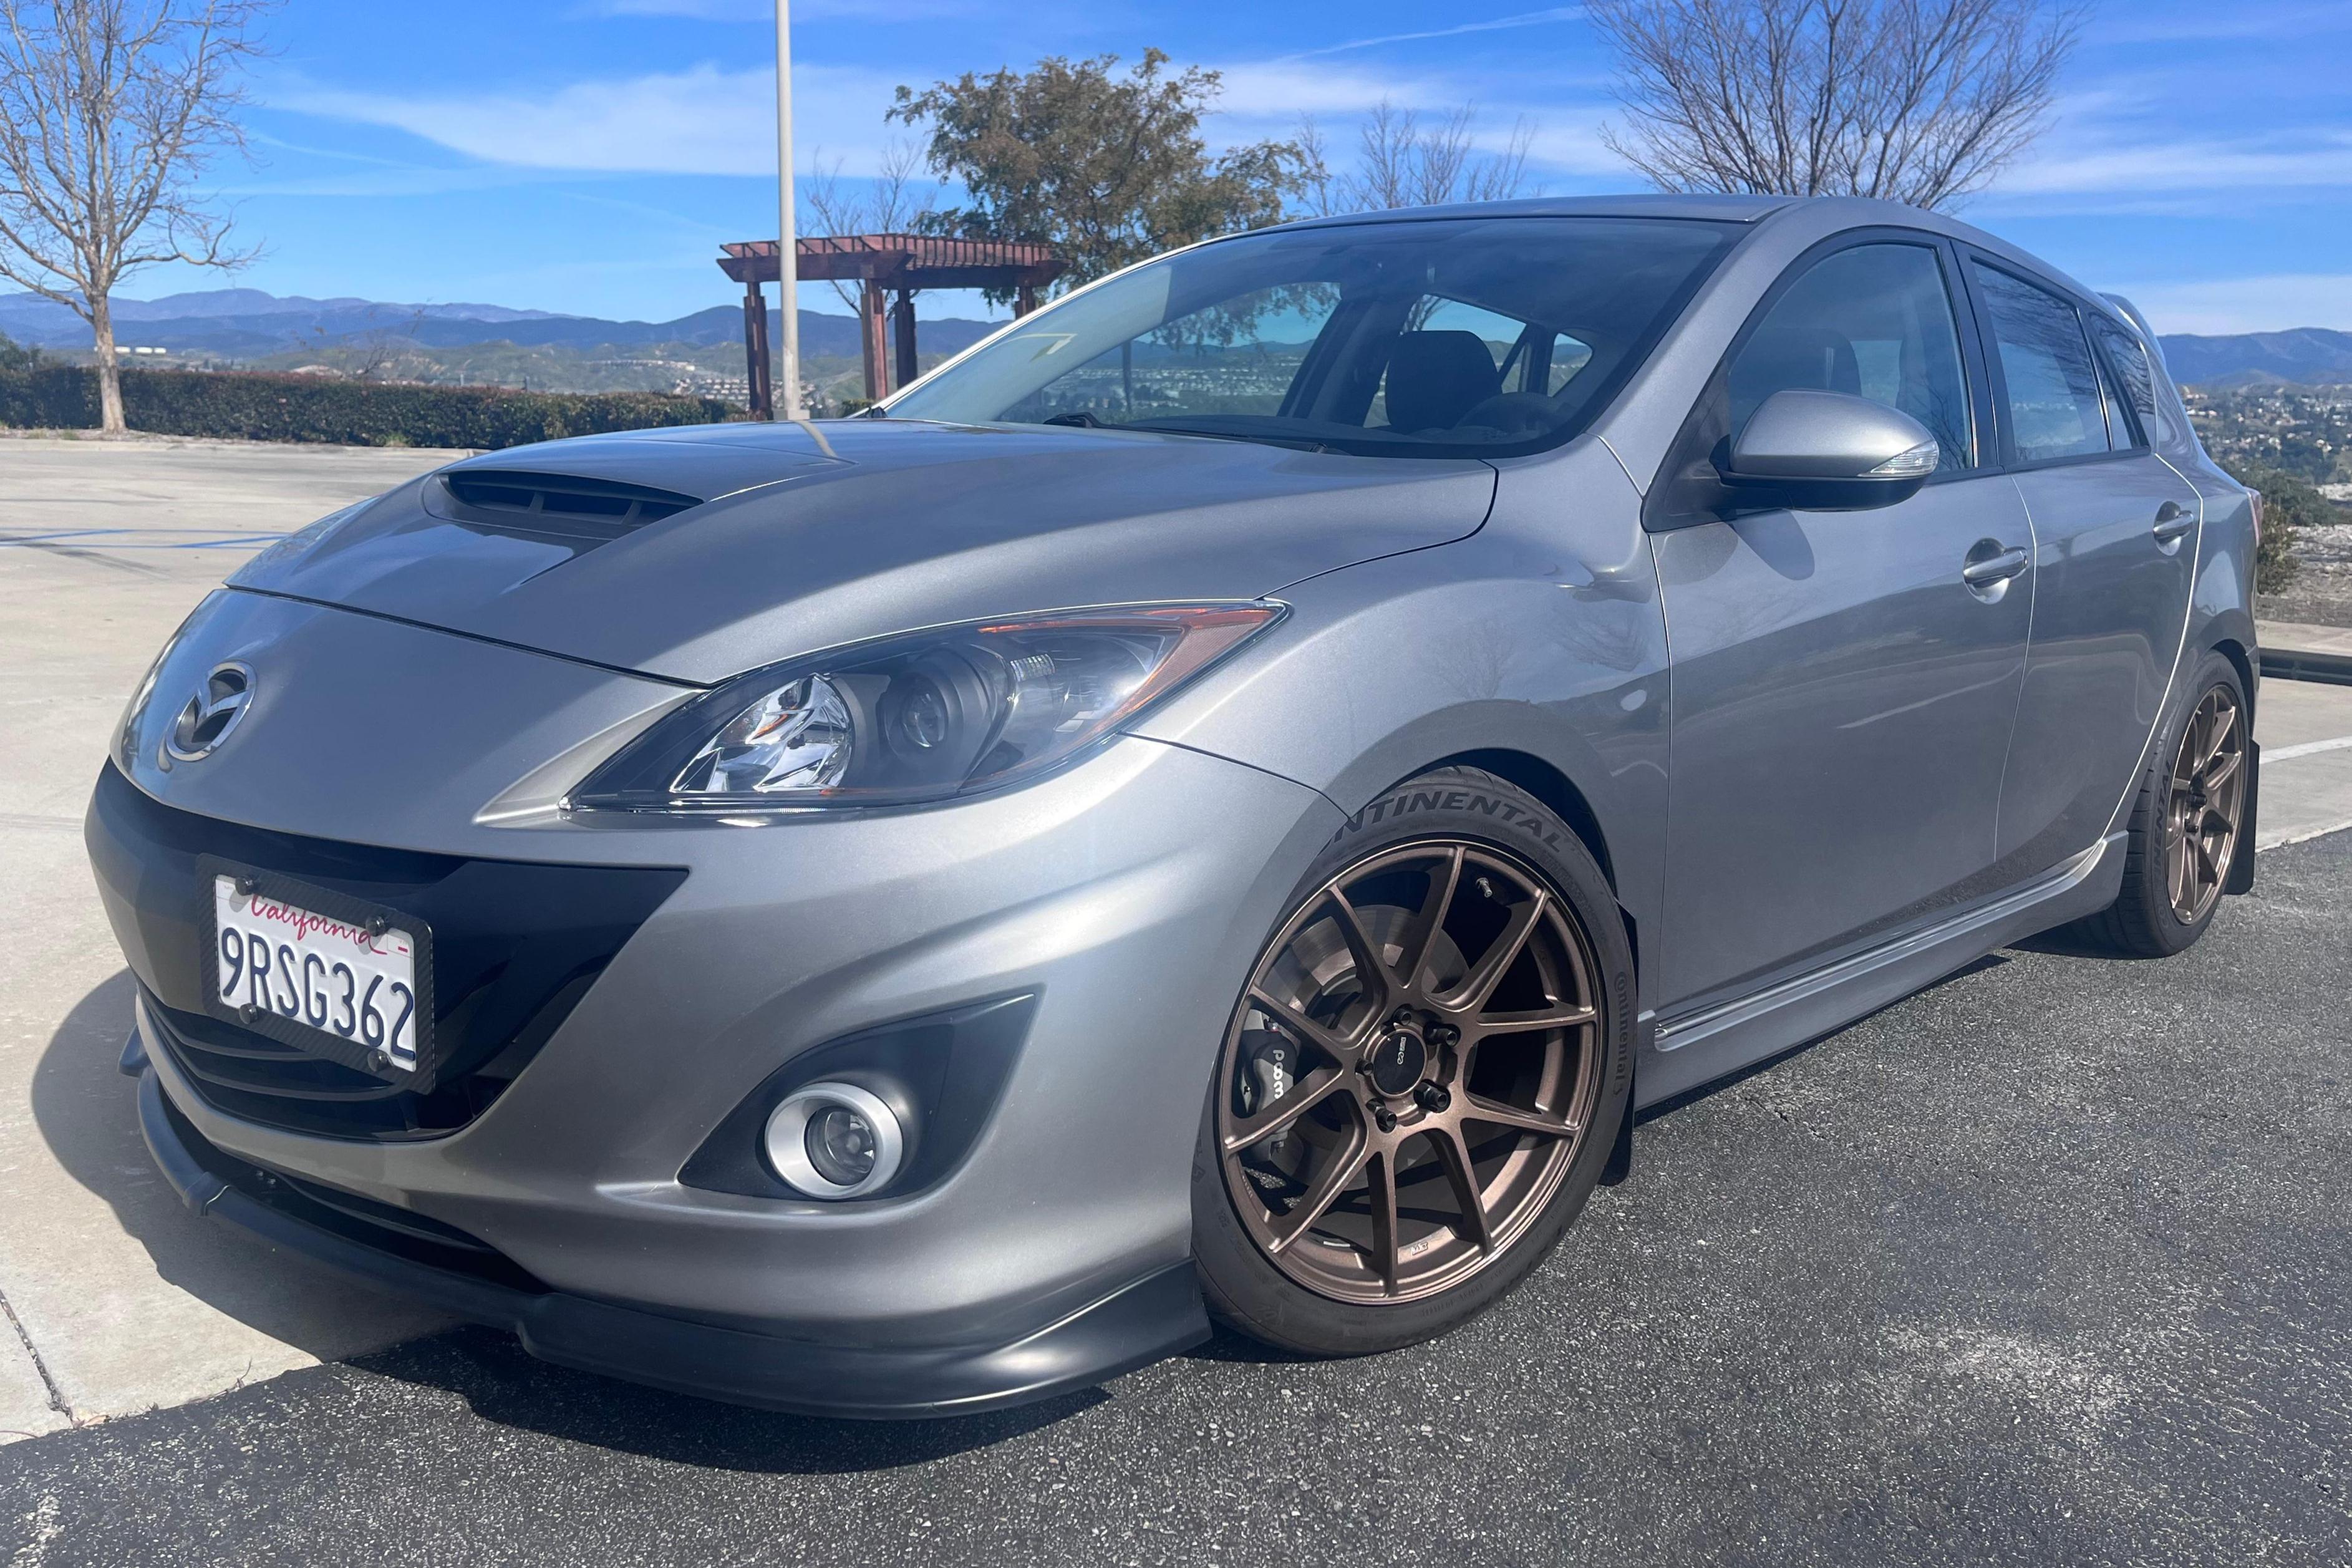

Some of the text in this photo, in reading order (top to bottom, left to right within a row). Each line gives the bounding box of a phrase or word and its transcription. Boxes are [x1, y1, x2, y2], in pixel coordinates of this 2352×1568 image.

[1328, 791, 1562, 853] NTINENTAL
[251, 894, 387, 955] California
[221, 927, 415, 1061] 9RSG362
[1614, 971, 1630, 1081] Continental
